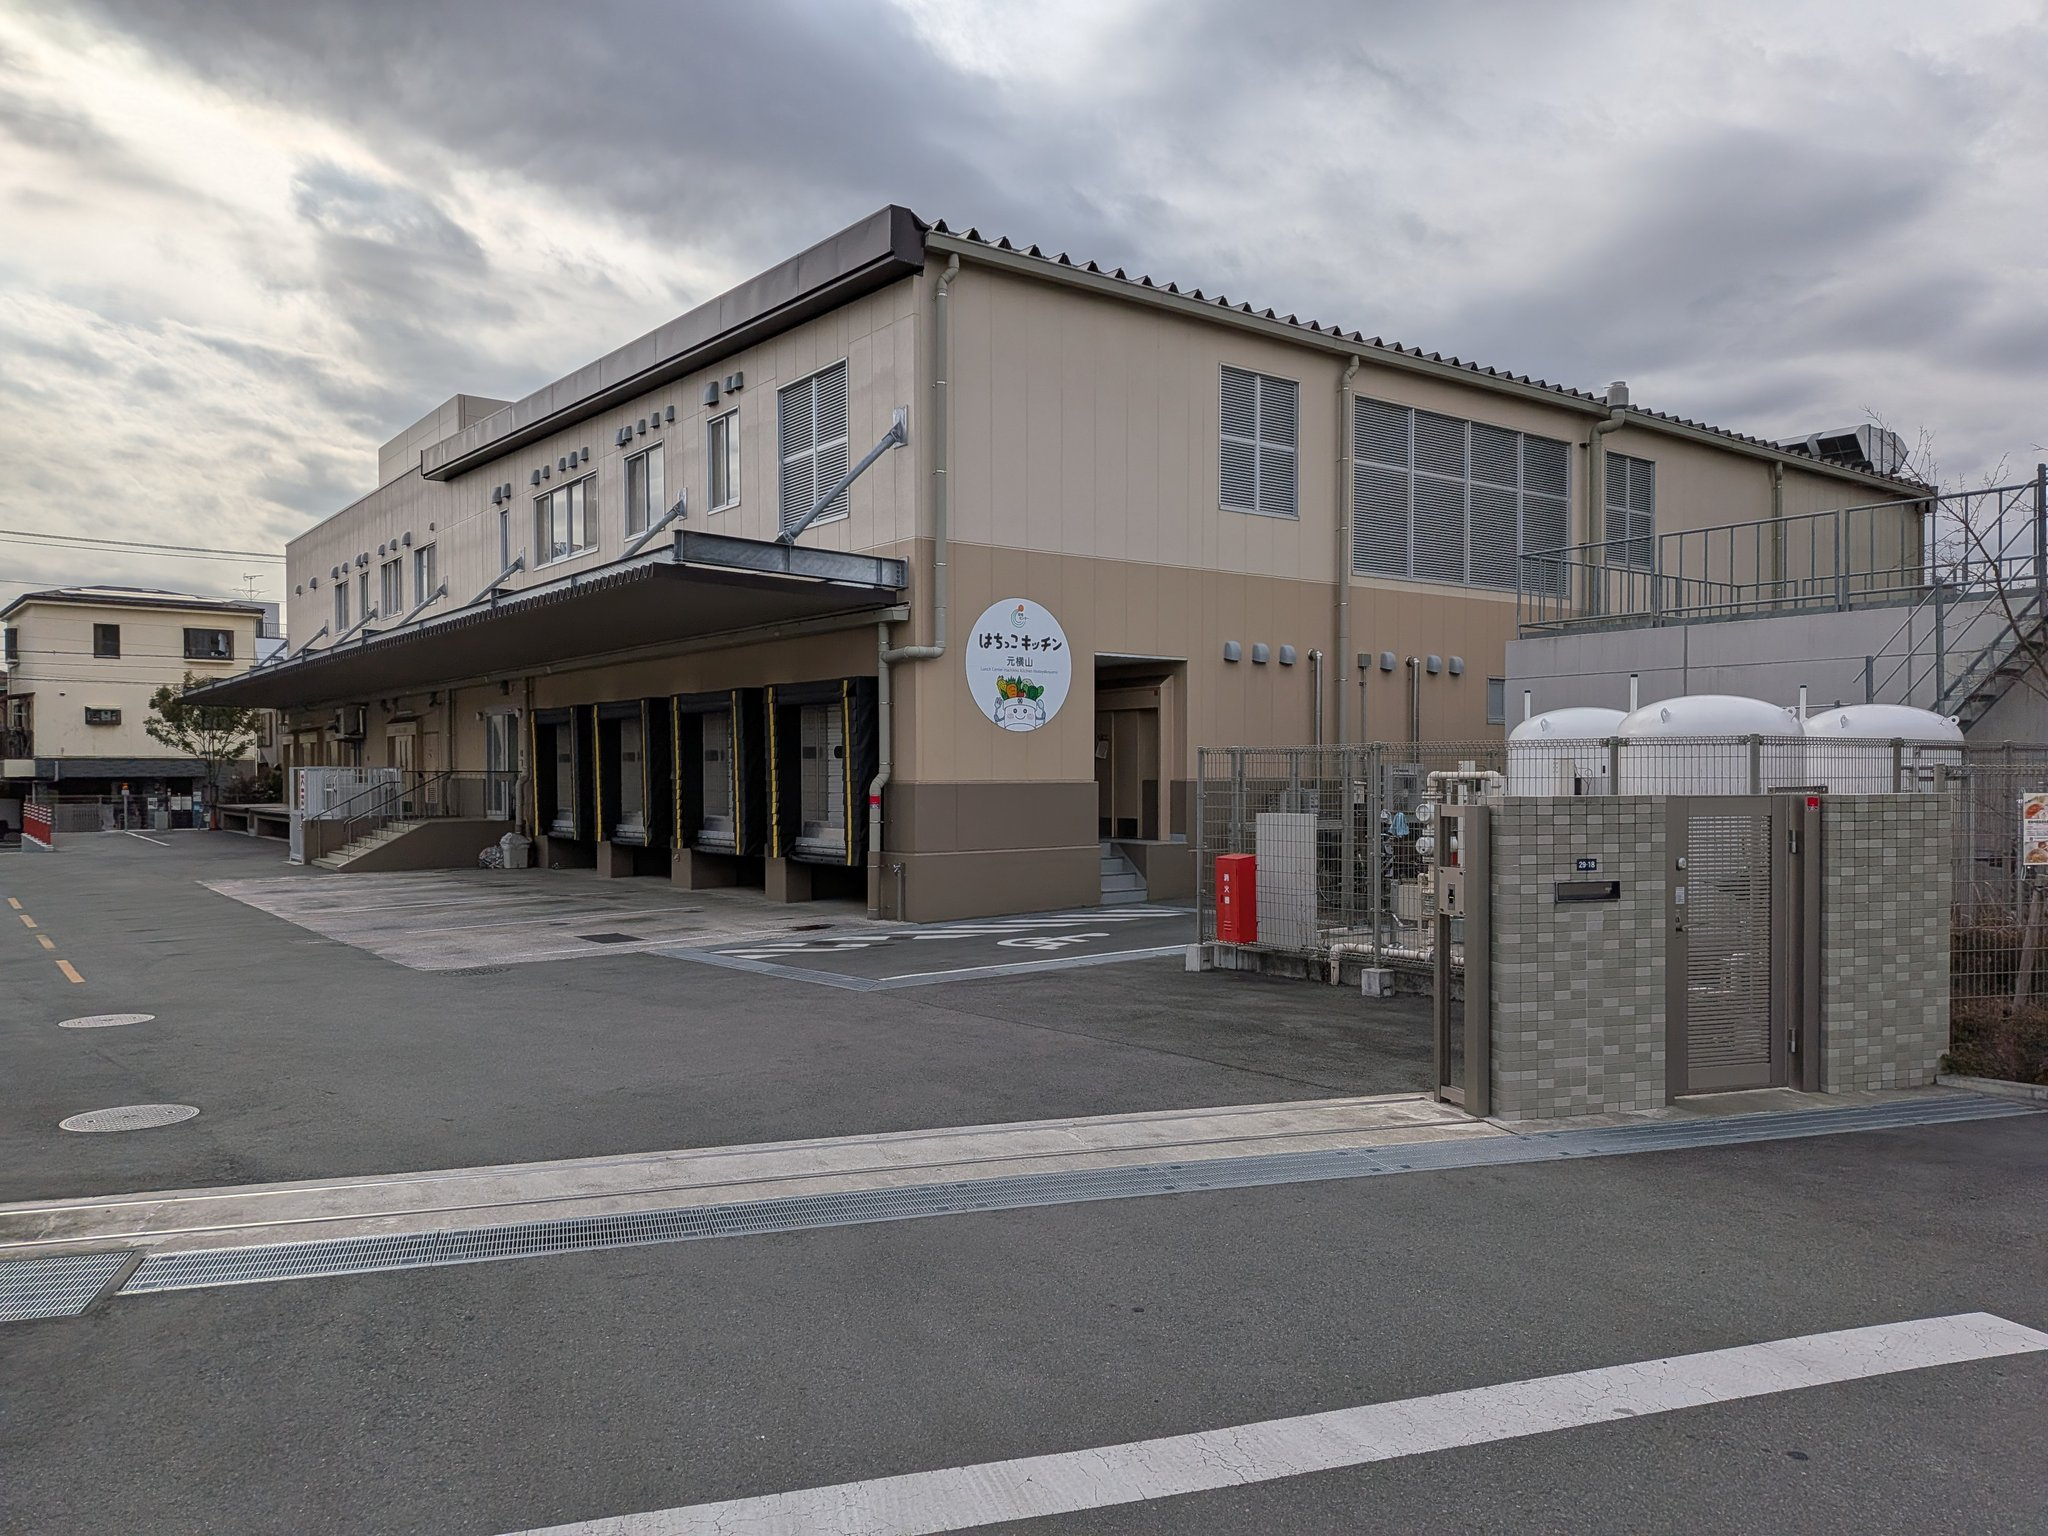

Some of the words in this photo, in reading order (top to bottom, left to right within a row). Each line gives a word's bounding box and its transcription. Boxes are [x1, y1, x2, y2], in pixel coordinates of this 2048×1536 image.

[979, 633, 1063, 652] はちっこキッチン
[1006, 656, 1034, 668] 元横山
[1578, 861, 1596, 869] 29-18
